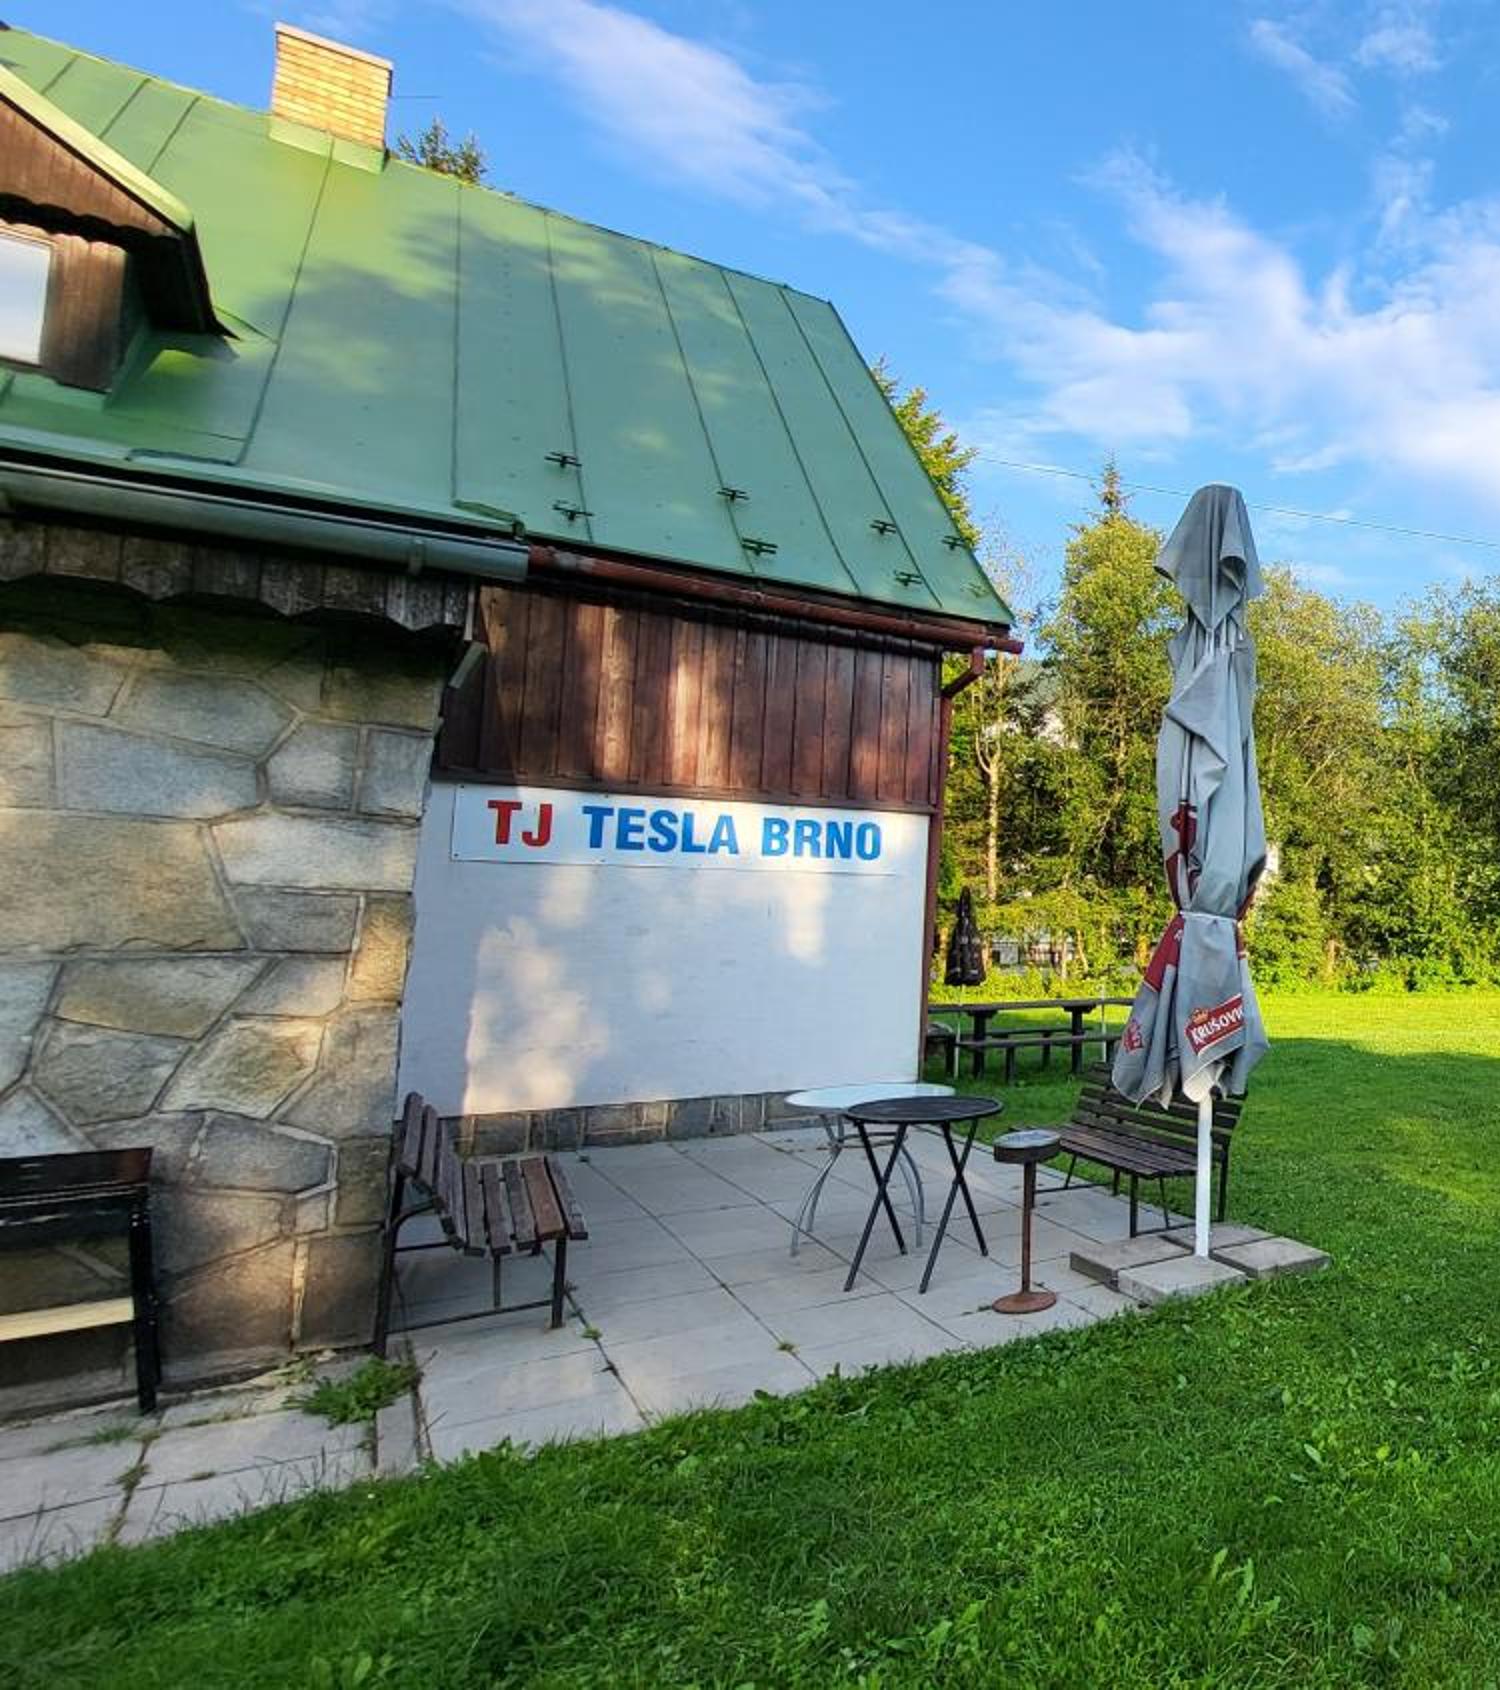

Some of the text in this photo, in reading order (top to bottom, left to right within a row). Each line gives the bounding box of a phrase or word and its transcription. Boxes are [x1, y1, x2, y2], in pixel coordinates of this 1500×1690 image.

[487, 800, 881, 861] TJ TESLA BRNO
